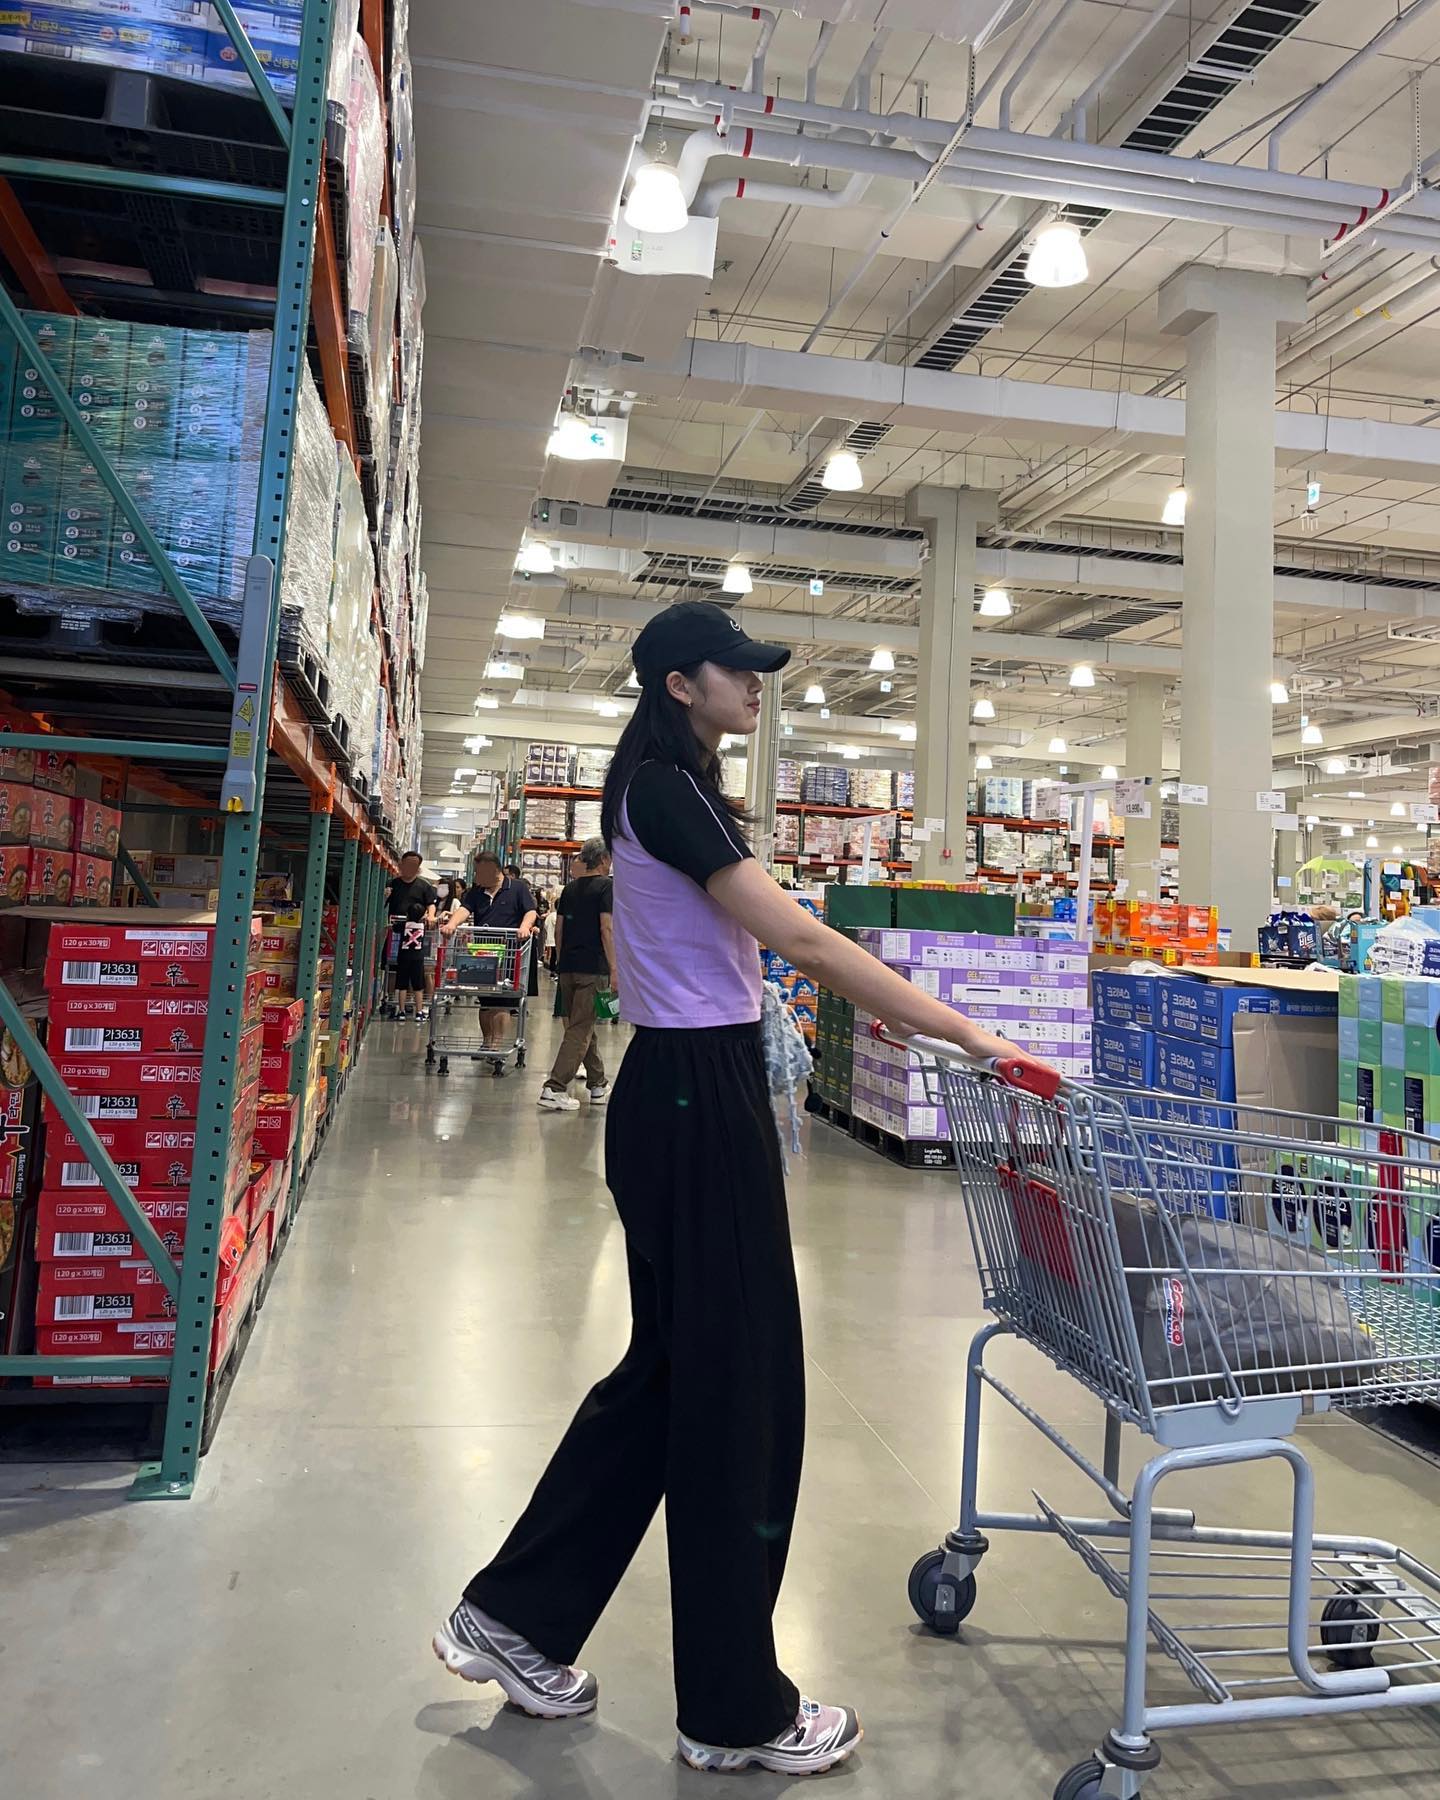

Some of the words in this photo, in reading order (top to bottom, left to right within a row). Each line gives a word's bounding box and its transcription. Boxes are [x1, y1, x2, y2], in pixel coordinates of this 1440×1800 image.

[101, 963, 137, 975] 가3631
[266, 975, 276, 986] 면
[1106, 986, 1131, 999] 크리넥스
[1172, 994, 1197, 1009] 크리넥스
[105, 1029, 141, 1040] 가3631
[1170, 1053, 1196, 1069] 크리넥스
[8, 1092, 21, 1119] 라면
[101, 1096, 137, 1107] 가3631
[94, 1233, 131, 1244] 가3631
[57, 1270, 69, 1278] 120
[95, 1296, 132, 1307] 가3631
